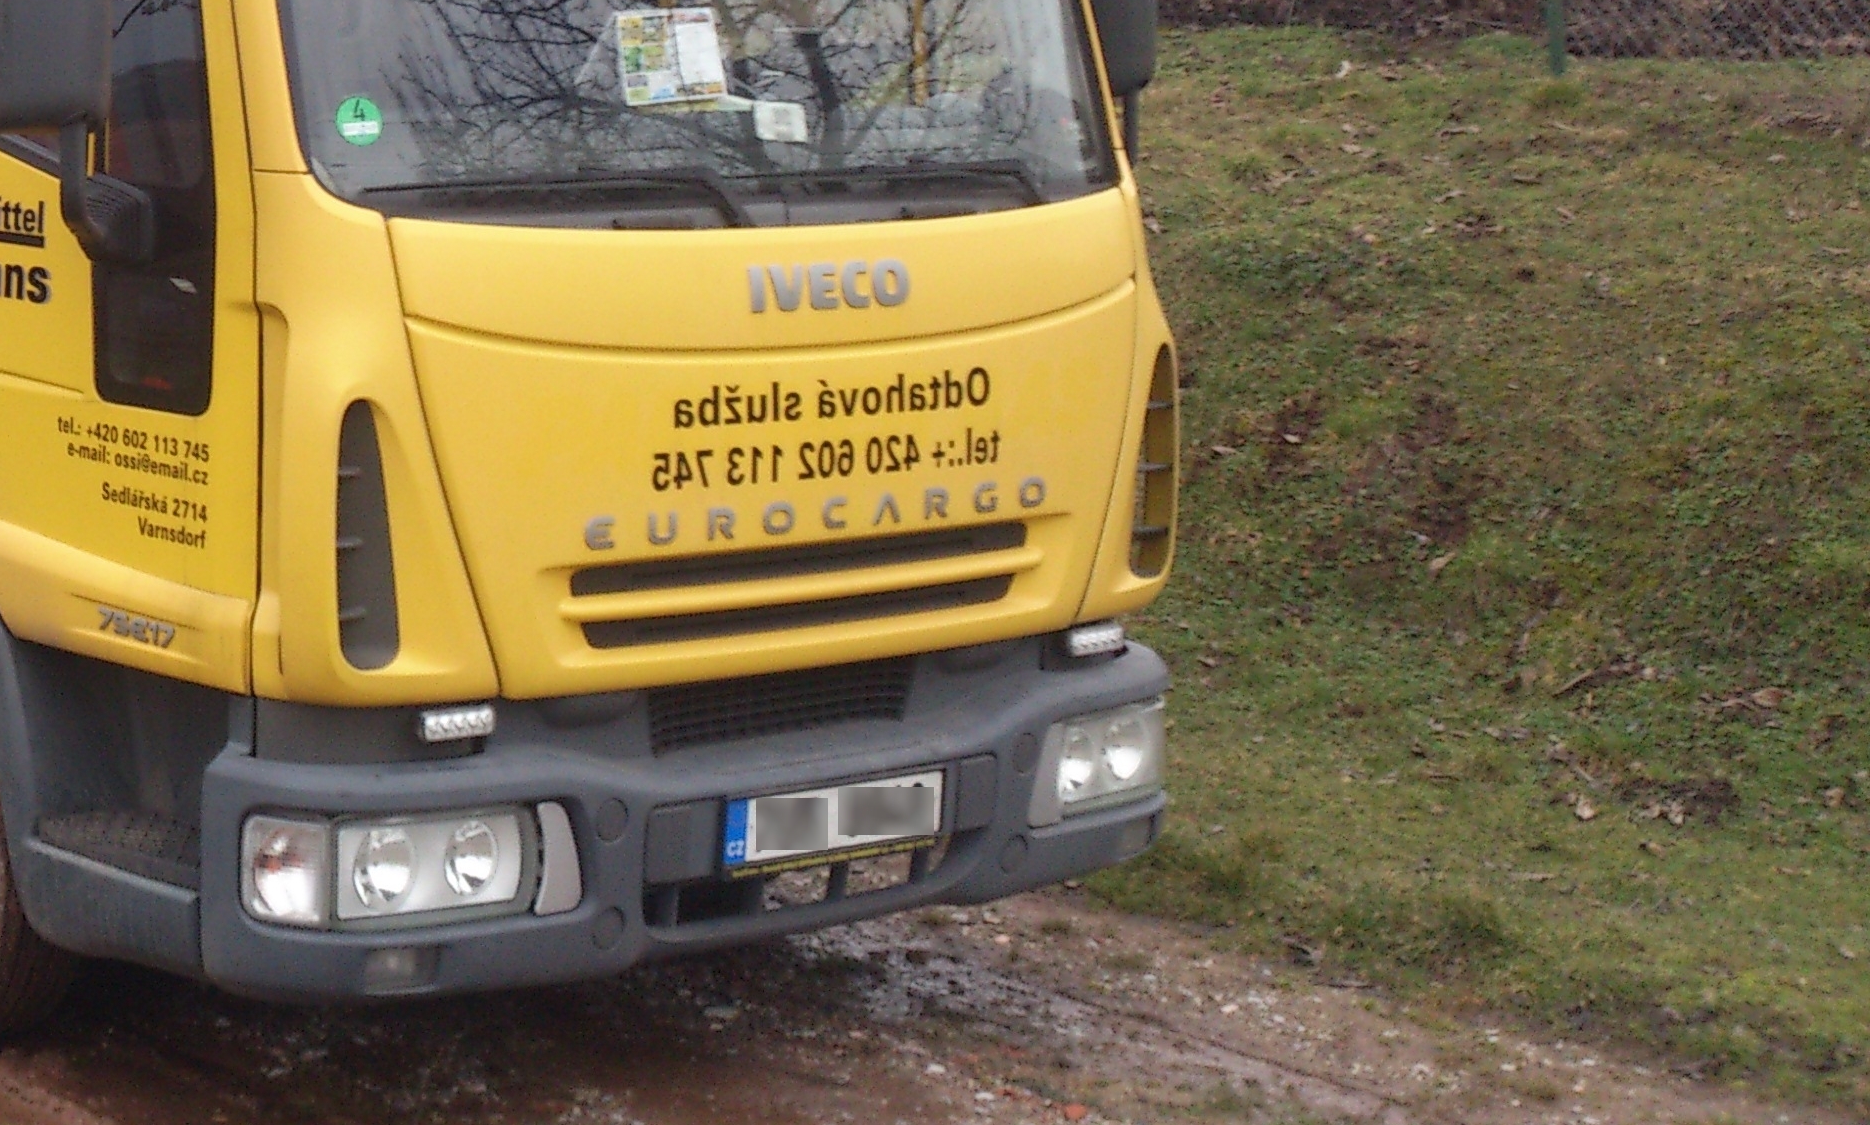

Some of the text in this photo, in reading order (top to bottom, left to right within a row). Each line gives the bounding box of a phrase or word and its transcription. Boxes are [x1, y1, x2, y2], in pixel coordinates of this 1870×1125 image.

[353, 99, 366, 122] 4
[747, 259, 910, 313] IVECO
[86, 423, 119, 445] +420
[122, 428, 148, 451] 602
[154, 434, 178, 457] 113
[183, 440, 210, 463] 745
[67, 442, 210, 486] e-mail: ossi@email.cz
[101, 481, 209, 524] Sedlářská 2714
[583, 476, 1048, 550] EUROCARGO
[138, 516, 207, 549] Varnsdorf
[726, 839, 745, 858] CZ
